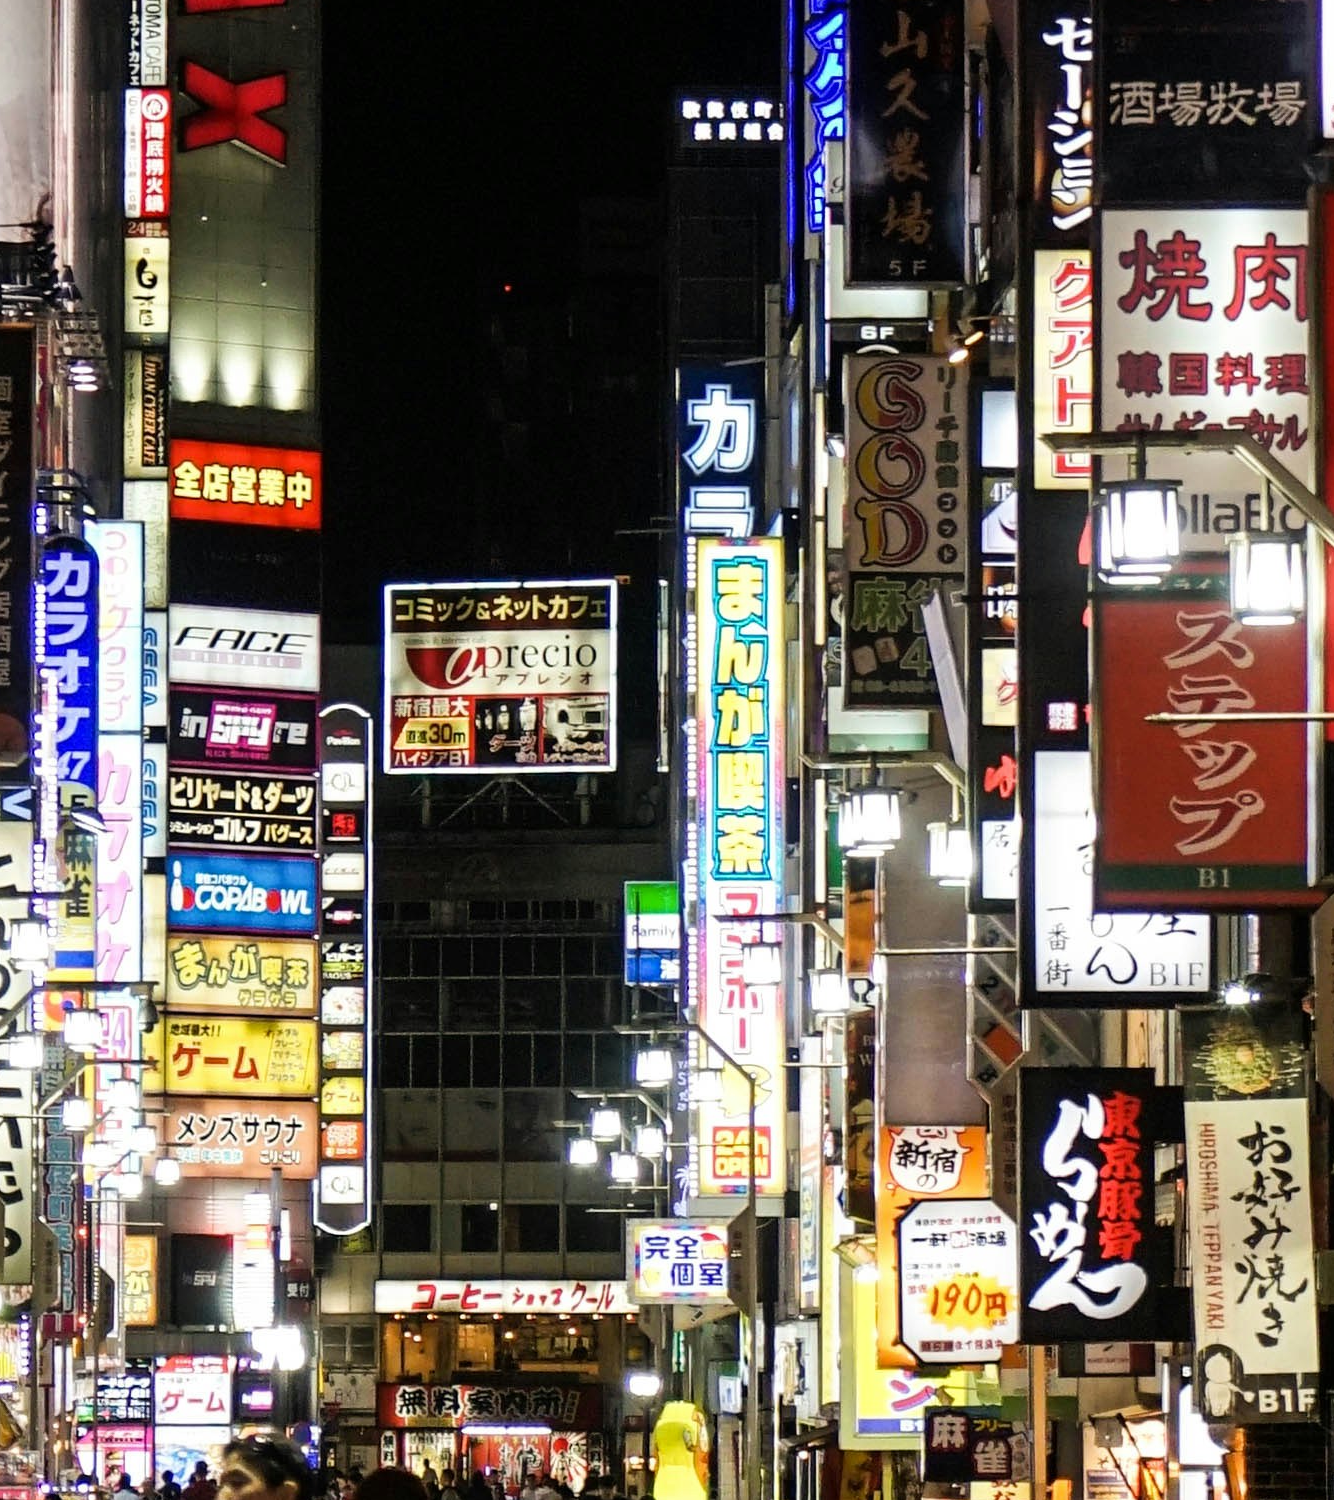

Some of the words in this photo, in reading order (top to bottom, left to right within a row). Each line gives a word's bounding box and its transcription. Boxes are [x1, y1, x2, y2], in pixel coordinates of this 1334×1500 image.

[145, 43, 163, 84] CAFE
[682, 100, 784, 119] 歌舞伎町
[1110, 81, 1306, 127] 酒場牧場
[889, 260, 927, 275] 5F
[1118, 229, 1308, 322] 焼肉
[860, 325, 894, 340] 6F
[1116, 351, 1308, 397] 韓国料理
[854, 359, 929, 568] GOD
[174, 460, 312, 508] 全店営業中
[395, 594, 607, 623] コミック&ネットカフェ
[174, 626, 313, 655] FACE
[143, 627, 158, 706] SEGA
[445, 634, 597, 686] aprecio
[495, 672, 594, 687] アプレシオ
[394, 698, 470, 717] 新宿最大
[713, 560, 768, 877] まんが喫茶
[1162, 610, 1265, 856] ステップ
[143, 758, 158, 838] SEGA
[170, 776, 314, 816] ビリヤード&ダーツ
[214, 817, 263, 843] ゴルフ
[1196, 868, 1230, 889] B1
[172, 941, 309, 989] まんが喫茶
[1045, 906, 1073, 987] 一番街
[1149, 961, 1204, 988] B1F
[172, 1041, 259, 1081] ゲーム
[177, 1114, 303, 1145] メンズサウナ
[896, 1139, 958, 1176] 新宿
[1098, 1090, 1143, 1261] 東京豚骨
[1198, 1122, 1220, 1213] HIROSHIMA
[643, 1235, 700, 1261] 完全
[1230, 1121, 1309, 1348] お好み焼き
[669, 1262, 725, 1287] 個室
[410, 1284, 503, 1310] コーヒー
[569, 1282, 615, 1308] クール
[931, 1282, 1007, 1318] 190円
[162, 1390, 227, 1413] ゲーム
[1258, 1389, 1316, 1413] B1F
[972, 1418, 1012, 1433] フリー
